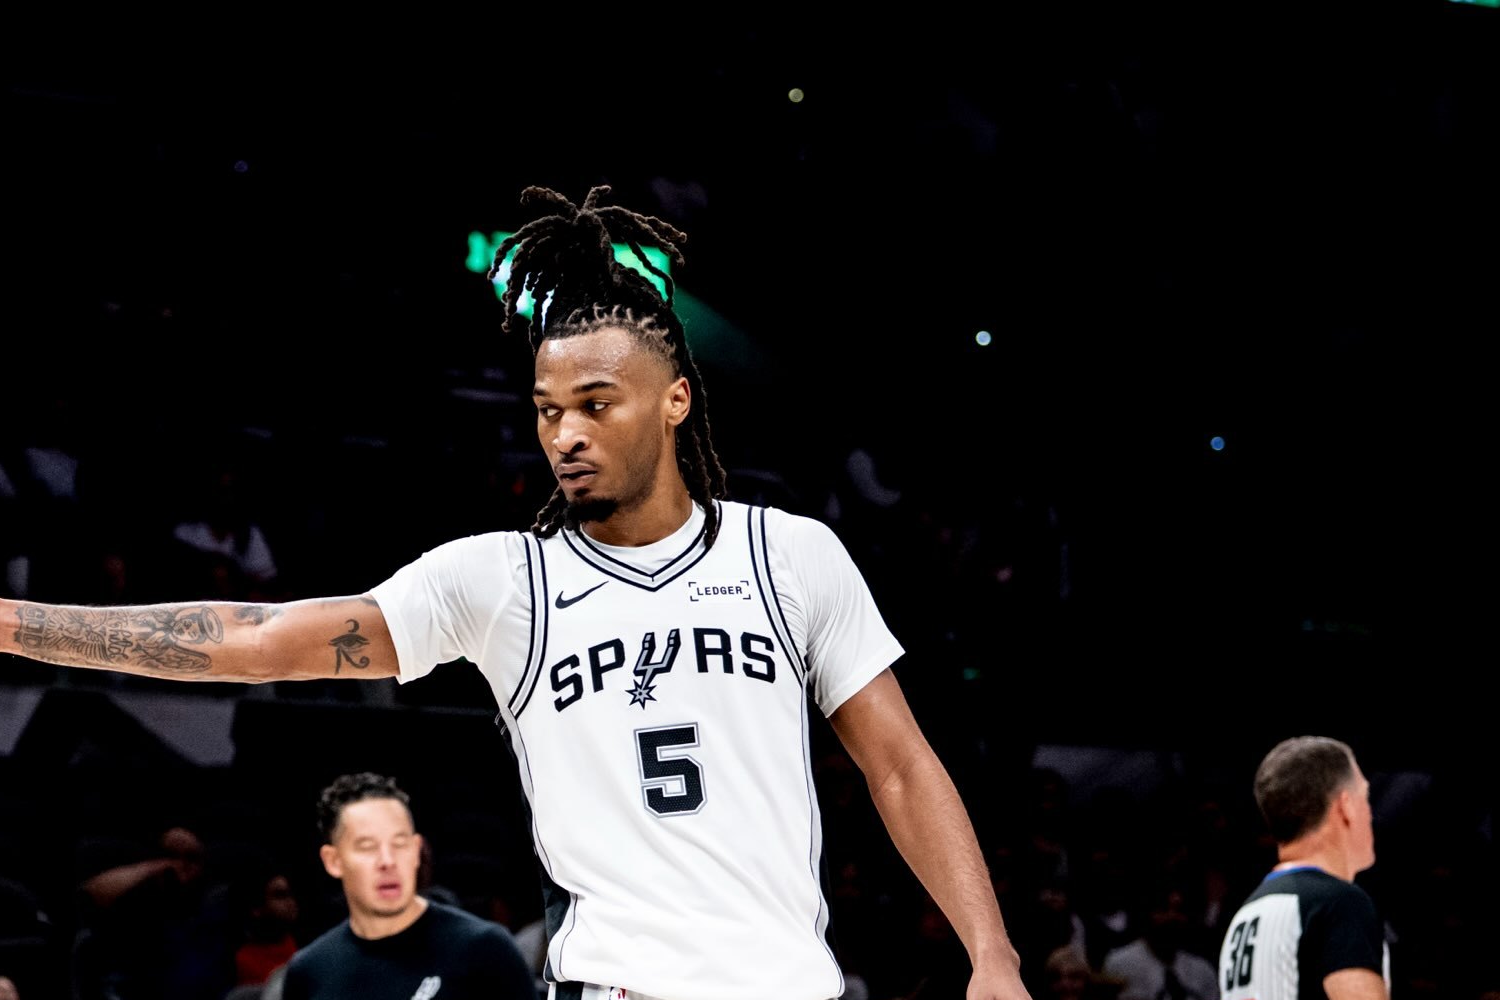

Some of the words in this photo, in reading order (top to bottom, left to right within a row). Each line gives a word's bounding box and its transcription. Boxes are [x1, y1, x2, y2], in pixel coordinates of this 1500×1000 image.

[696, 585, 743, 596] LEDGER
[550, 628, 776, 713] SPURS
[633, 721, 708, 818] 5
[1226, 916, 1260, 991] 36
